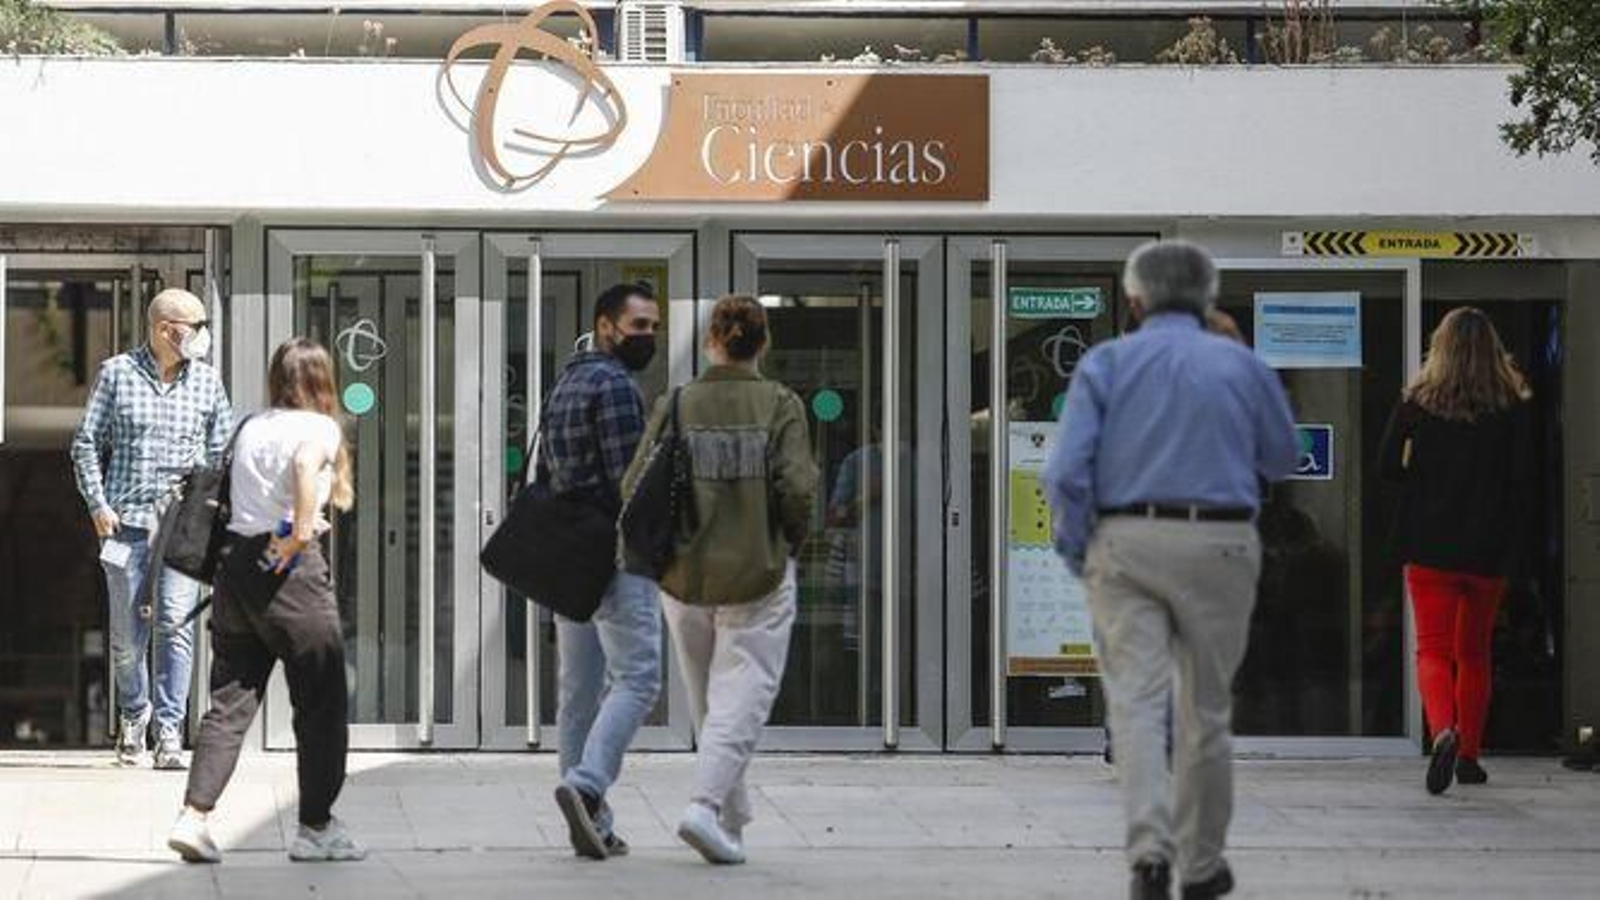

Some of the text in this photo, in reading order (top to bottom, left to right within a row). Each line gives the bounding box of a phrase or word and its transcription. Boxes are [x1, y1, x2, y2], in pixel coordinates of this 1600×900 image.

[701, 125, 947, 185] Ciencias
[1378, 236, 1442, 250] ENTRADA
[1012, 294, 1071, 311] ENTRADA
